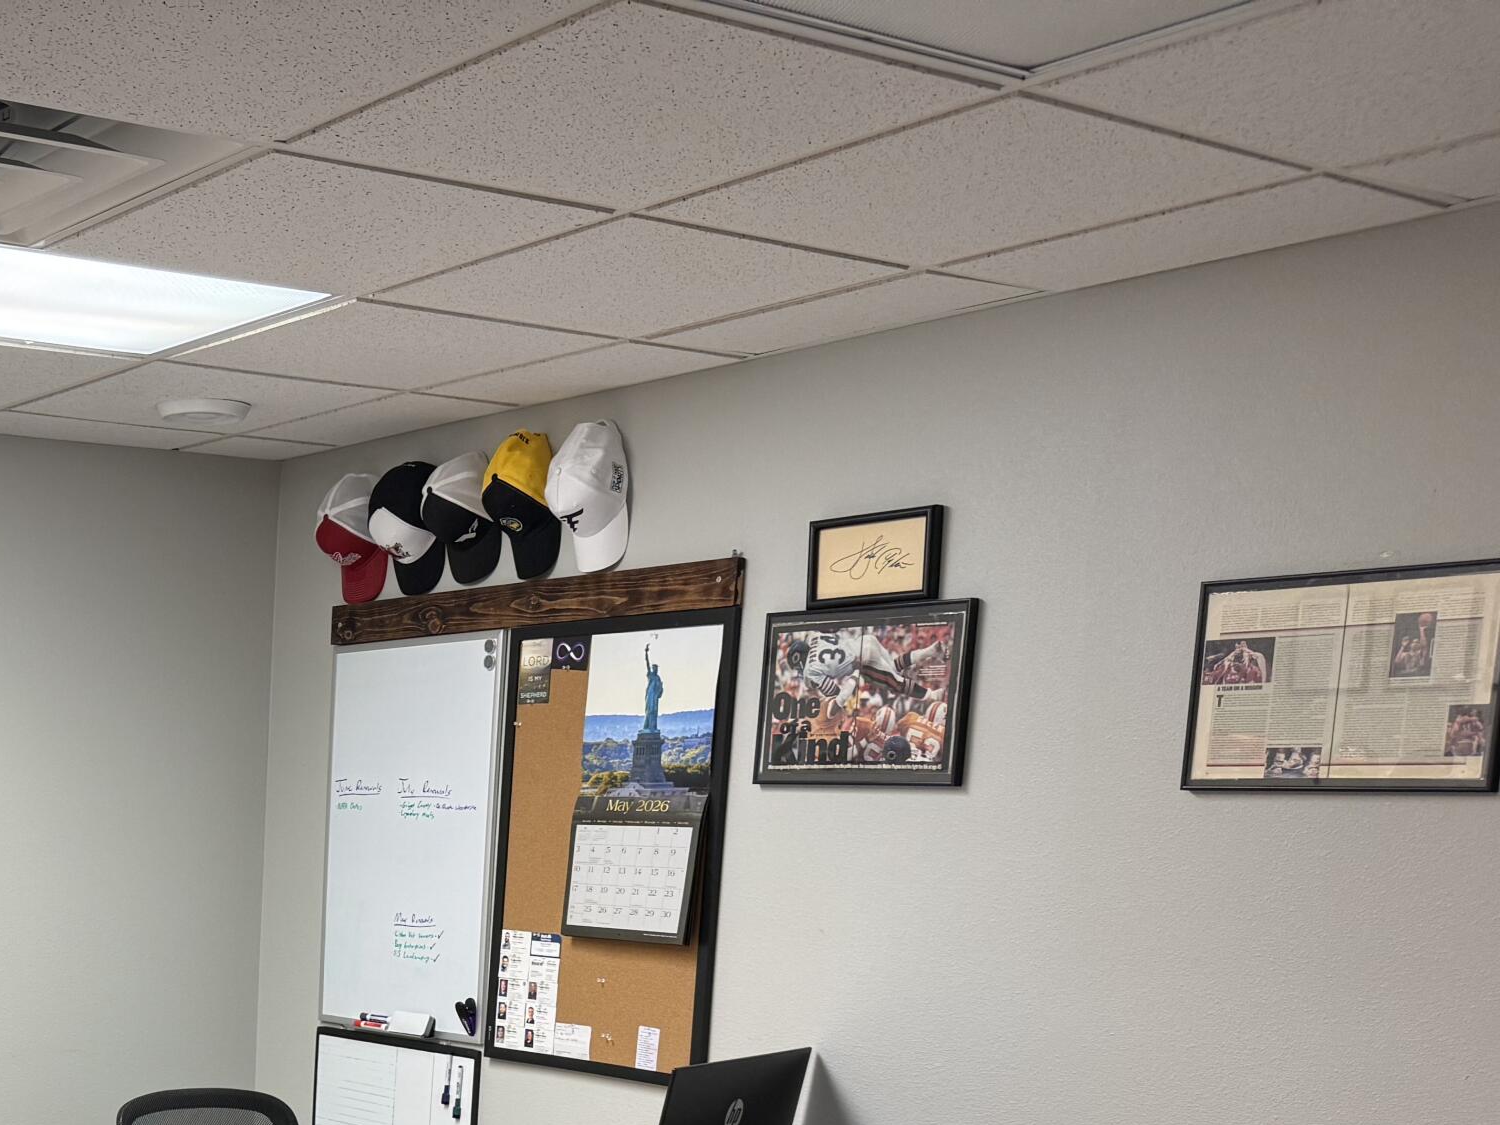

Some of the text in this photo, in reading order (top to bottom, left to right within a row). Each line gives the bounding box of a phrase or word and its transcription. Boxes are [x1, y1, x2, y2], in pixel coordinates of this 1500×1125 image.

[523, 655, 549, 667] LORD
[771, 692, 820, 719] One
[770, 731, 850, 763] Kind
[606, 799, 670, 814] May 2026
